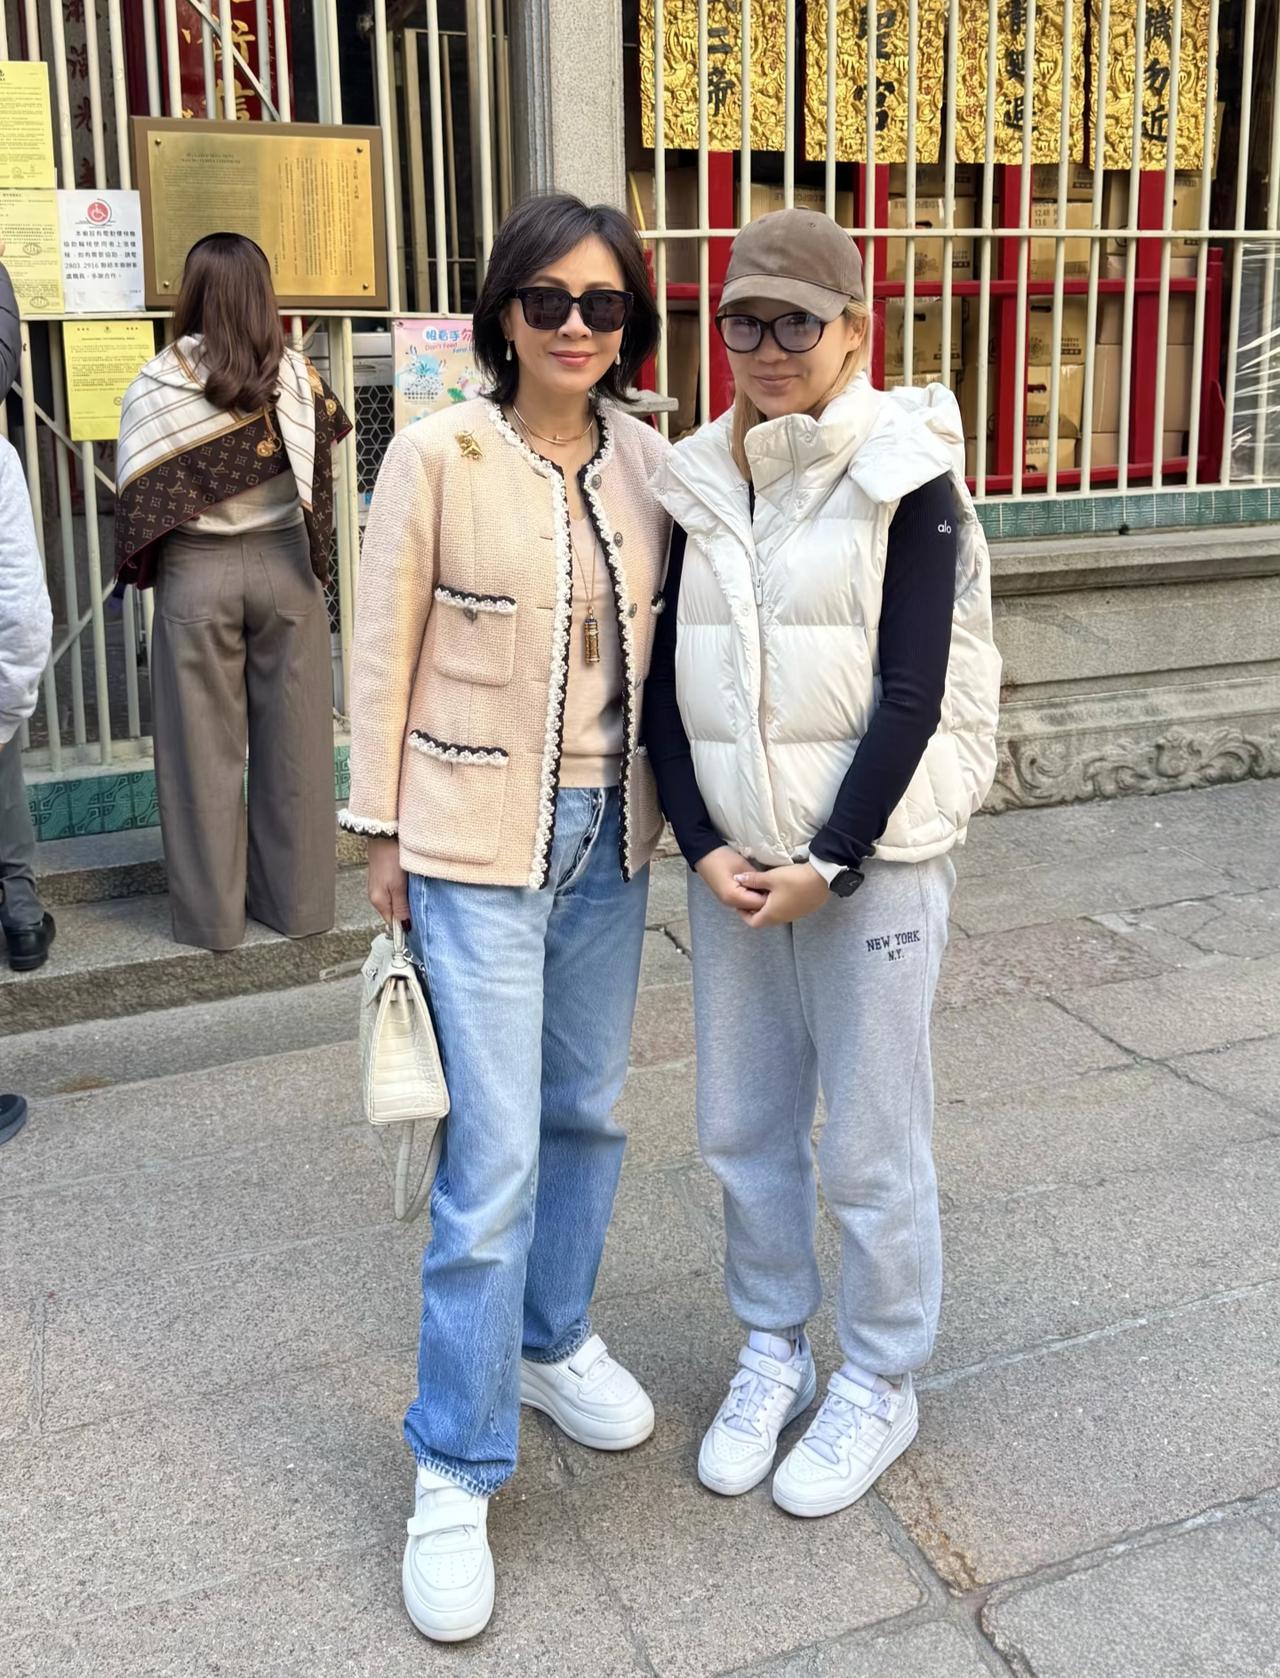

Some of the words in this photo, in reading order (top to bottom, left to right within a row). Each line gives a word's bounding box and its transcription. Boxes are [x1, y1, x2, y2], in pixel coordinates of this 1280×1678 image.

[937, 520, 952, 534] alo
[866, 935, 890, 952] NEW
[894, 930, 921, 945] YORK
[887, 949, 904, 961] N.Y.
